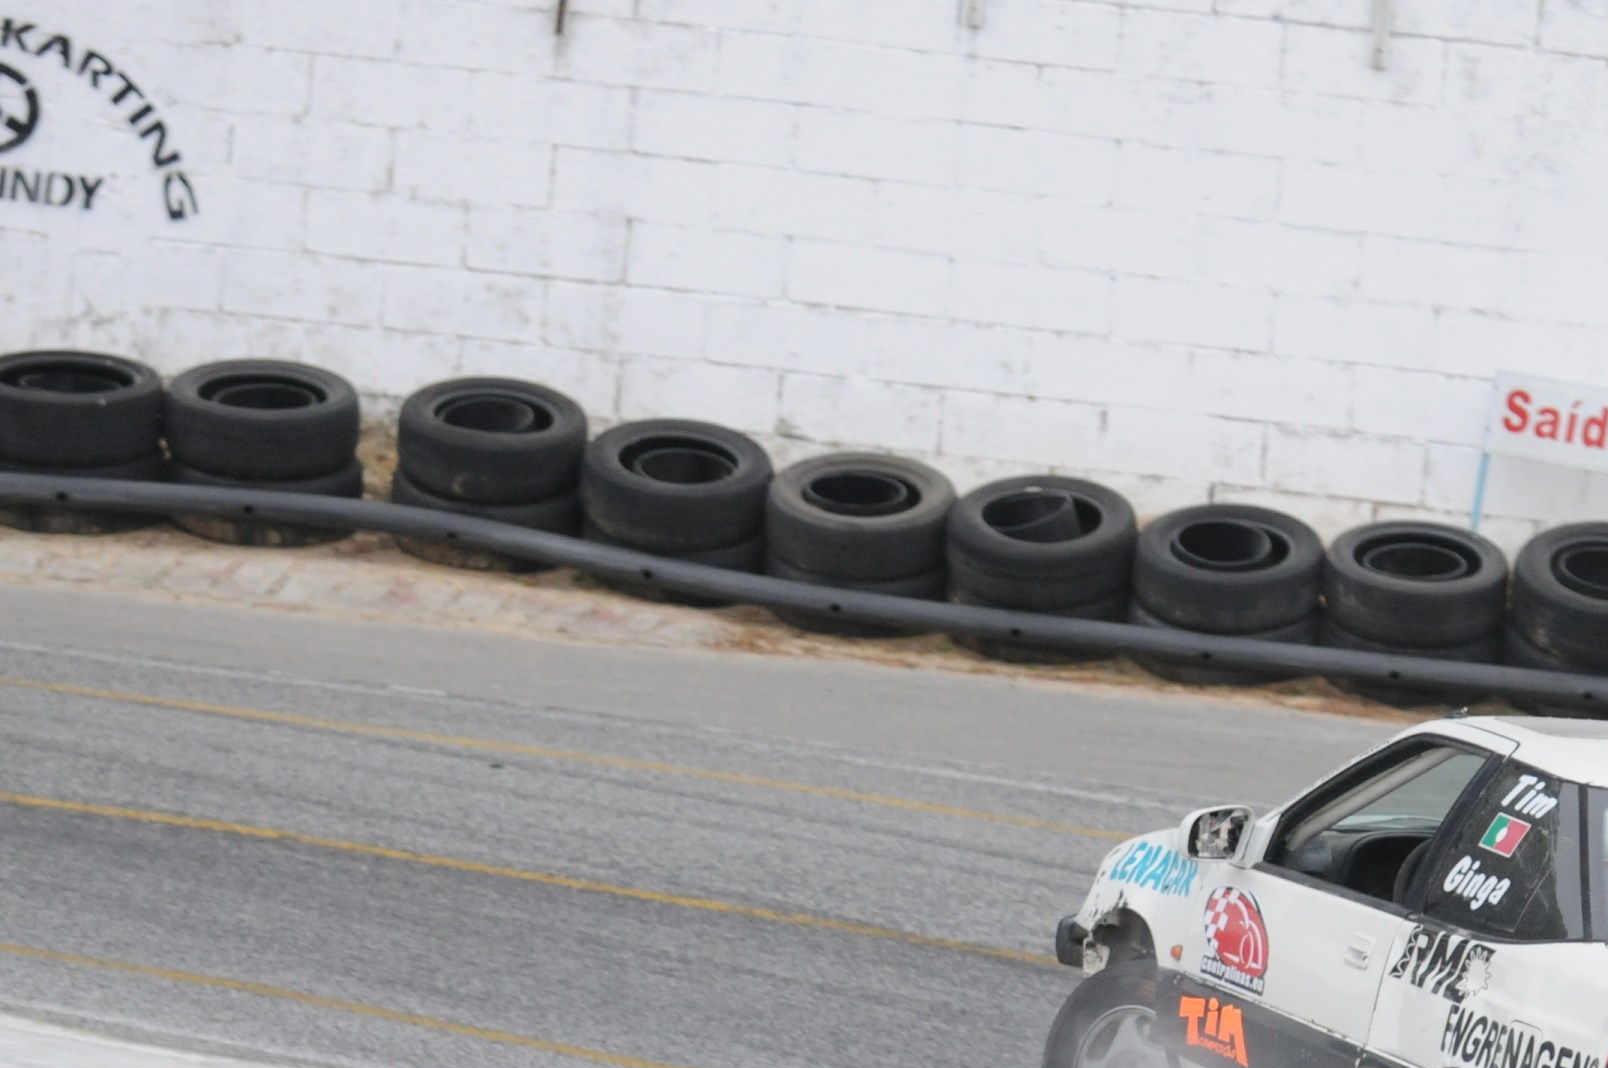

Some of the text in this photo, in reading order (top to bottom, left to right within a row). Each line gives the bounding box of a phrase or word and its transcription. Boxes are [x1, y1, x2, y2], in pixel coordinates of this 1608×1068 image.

[0, 18, 200, 220] KARTING
[0, 166, 103, 210] INDY
[1501, 774, 1558, 819] Tim
[1443, 855, 1511, 911] Ginga
